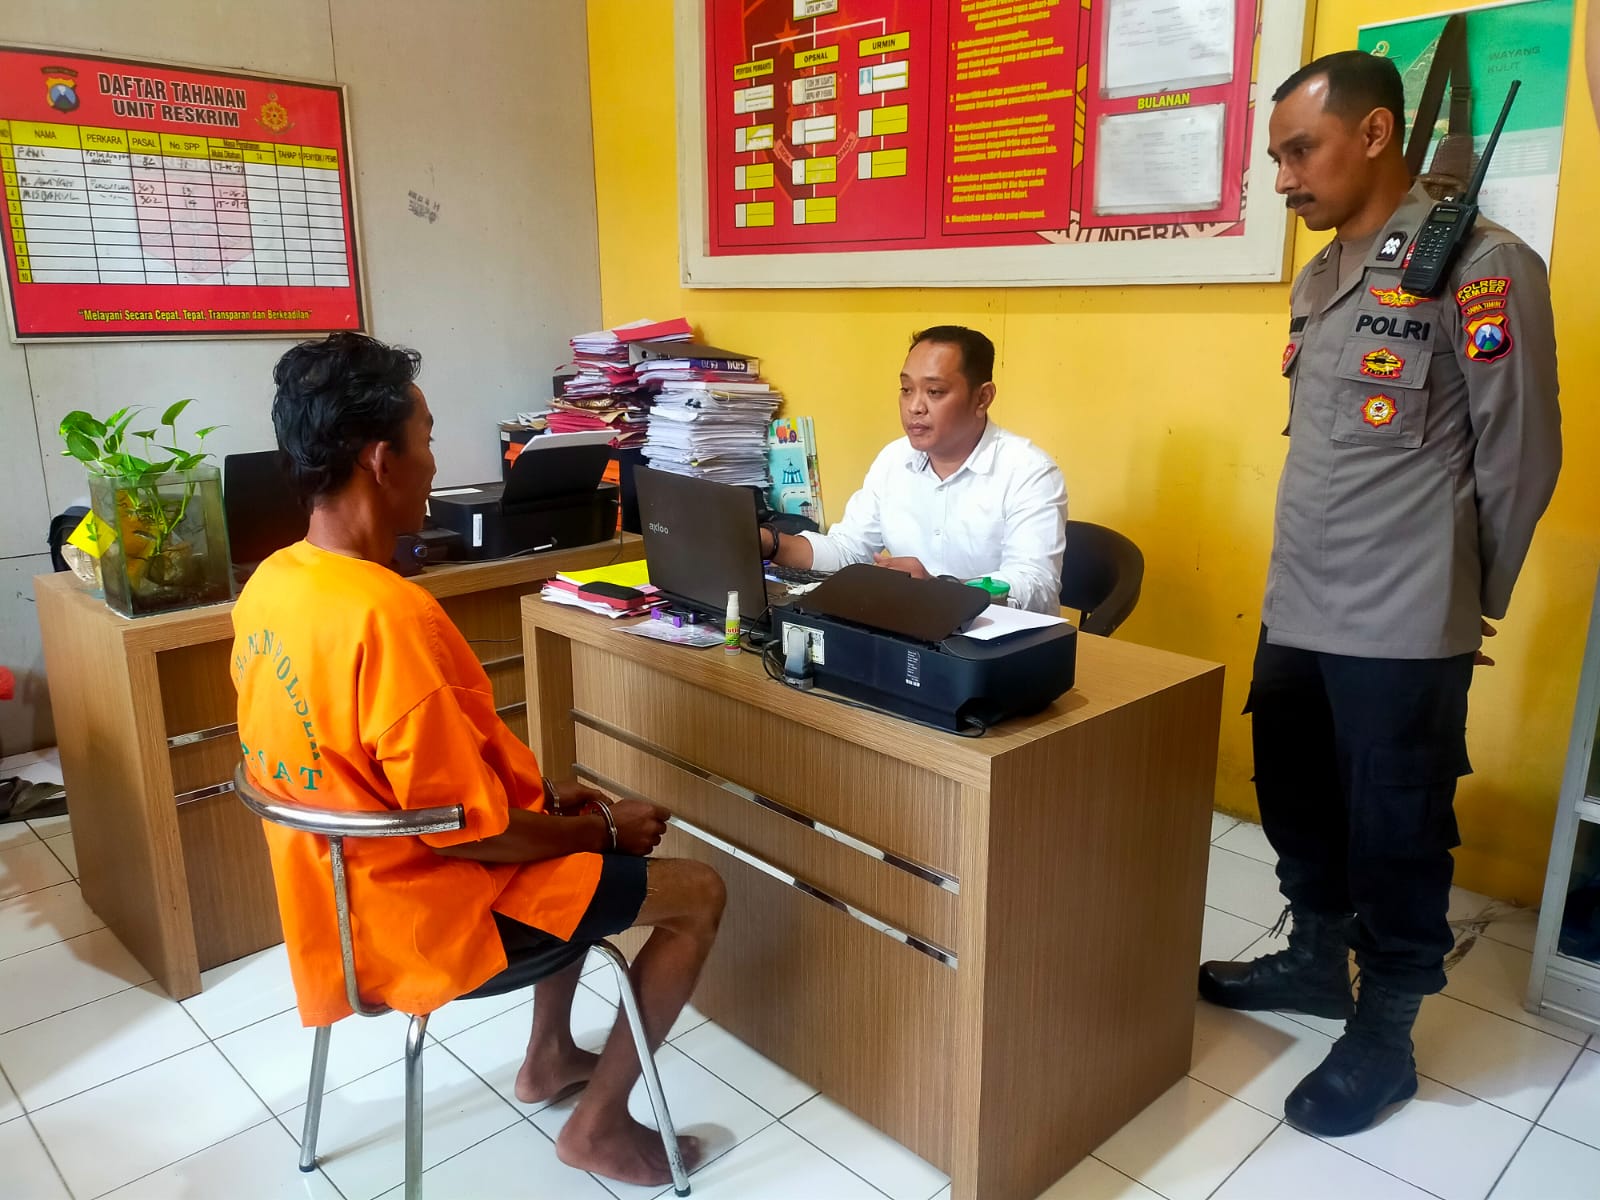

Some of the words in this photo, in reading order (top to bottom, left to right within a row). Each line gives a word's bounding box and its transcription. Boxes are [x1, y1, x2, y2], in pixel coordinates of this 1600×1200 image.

[872, 39, 896, 50] URMIN
[803, 52, 828, 63] OPSNAL
[97, 72, 168, 101] DAFTAR
[170, 81, 247, 110] TAHANAN
[1137, 92, 1190, 110] BULANAN
[112, 99, 156, 119] UNIT
[160, 104, 240, 128] RESKRIM
[34, 130, 56, 139] NAMA
[87, 134, 122, 145] PERKARA
[132, 138, 156, 148] PASAL
[184, 142, 200, 151] SPP
[1458, 280, 1505, 298] POLRES
[1461, 287, 1503, 302] JEMBER
[125, 309, 153, 321] Secara
[208, 309, 250, 321] Transparan
[252, 309, 266, 320] dan
[1356, 314, 1431, 341] POLRI
